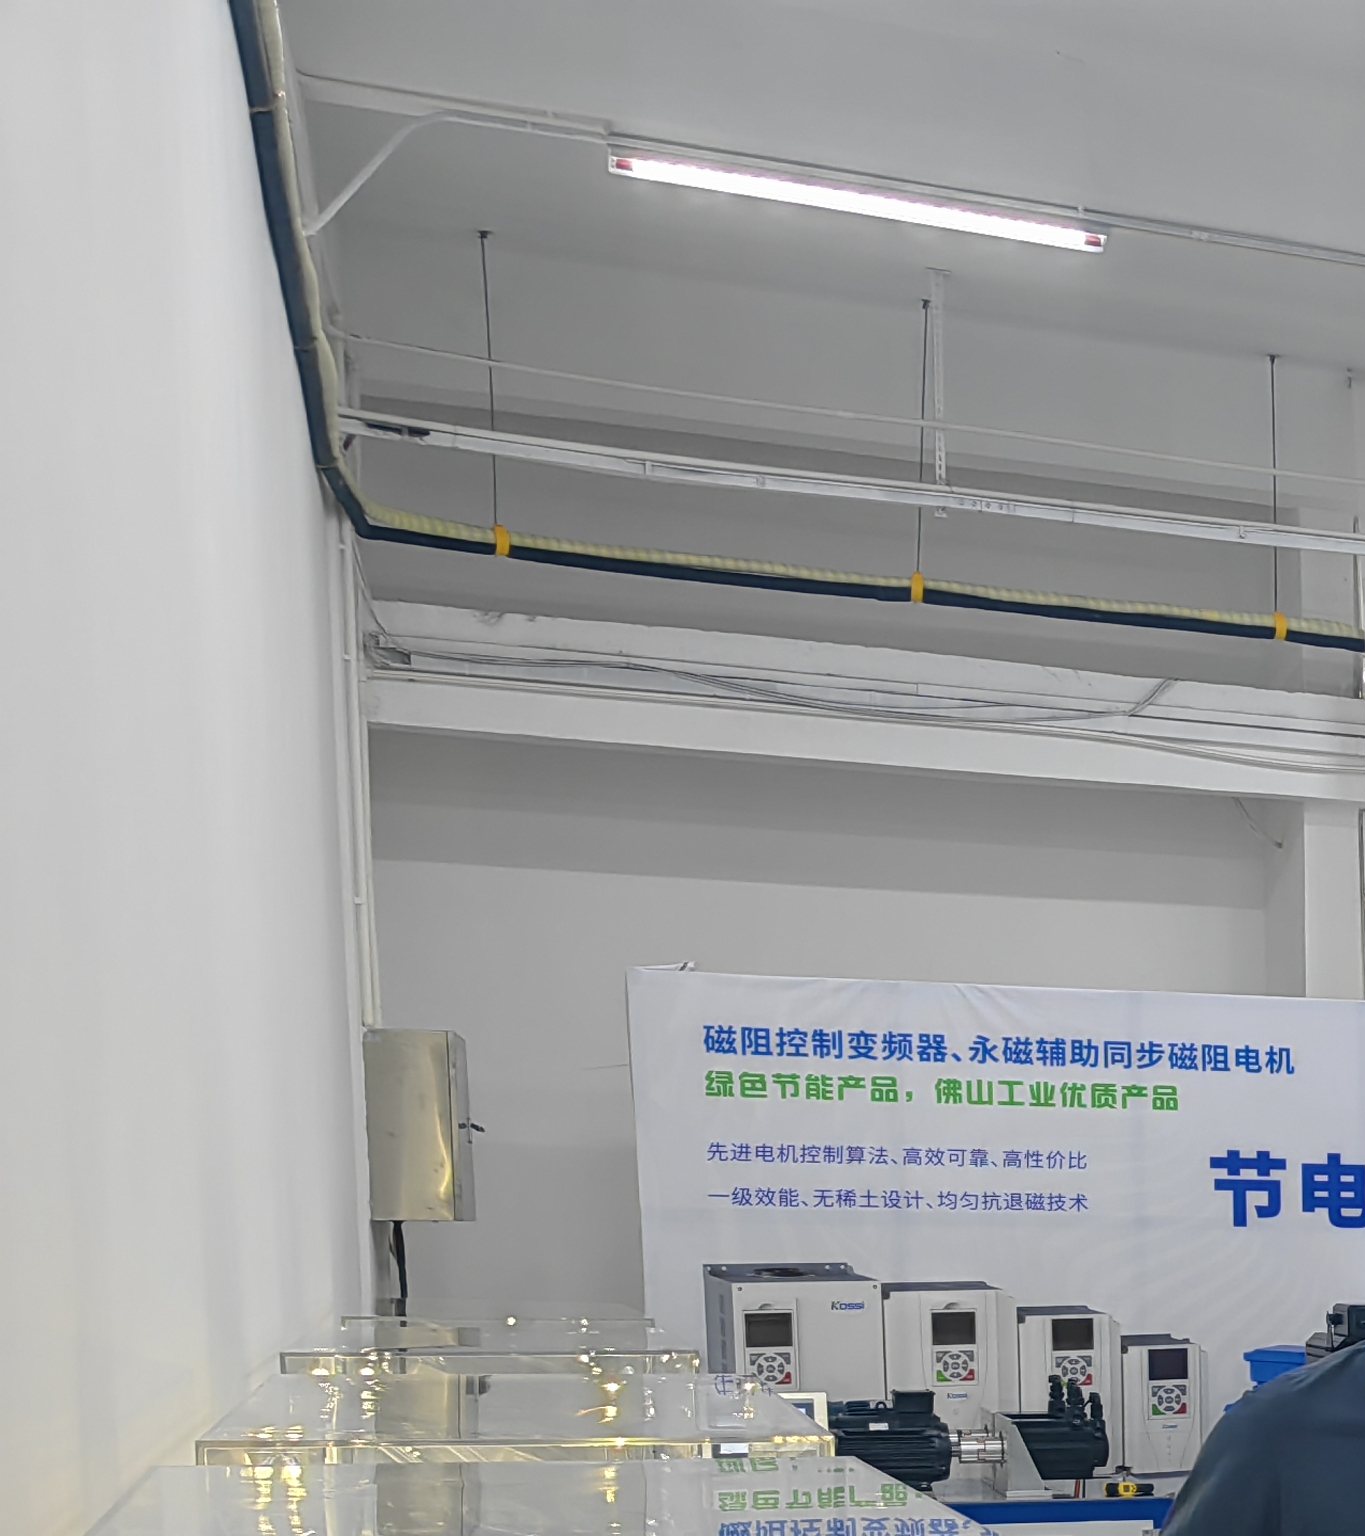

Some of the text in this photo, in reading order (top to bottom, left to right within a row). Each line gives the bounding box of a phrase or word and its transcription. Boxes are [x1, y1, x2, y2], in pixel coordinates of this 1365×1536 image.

[703, 1024, 1296, 1076] 磁阻控制变频器、永磁辅助同步磁阻电机
[704, 1070, 1179, 1112] 绿色节能产品，佛山工业优质产品
[706, 1141, 1088, 1171] 先进电机控制算法、高效可靠、高性价比
